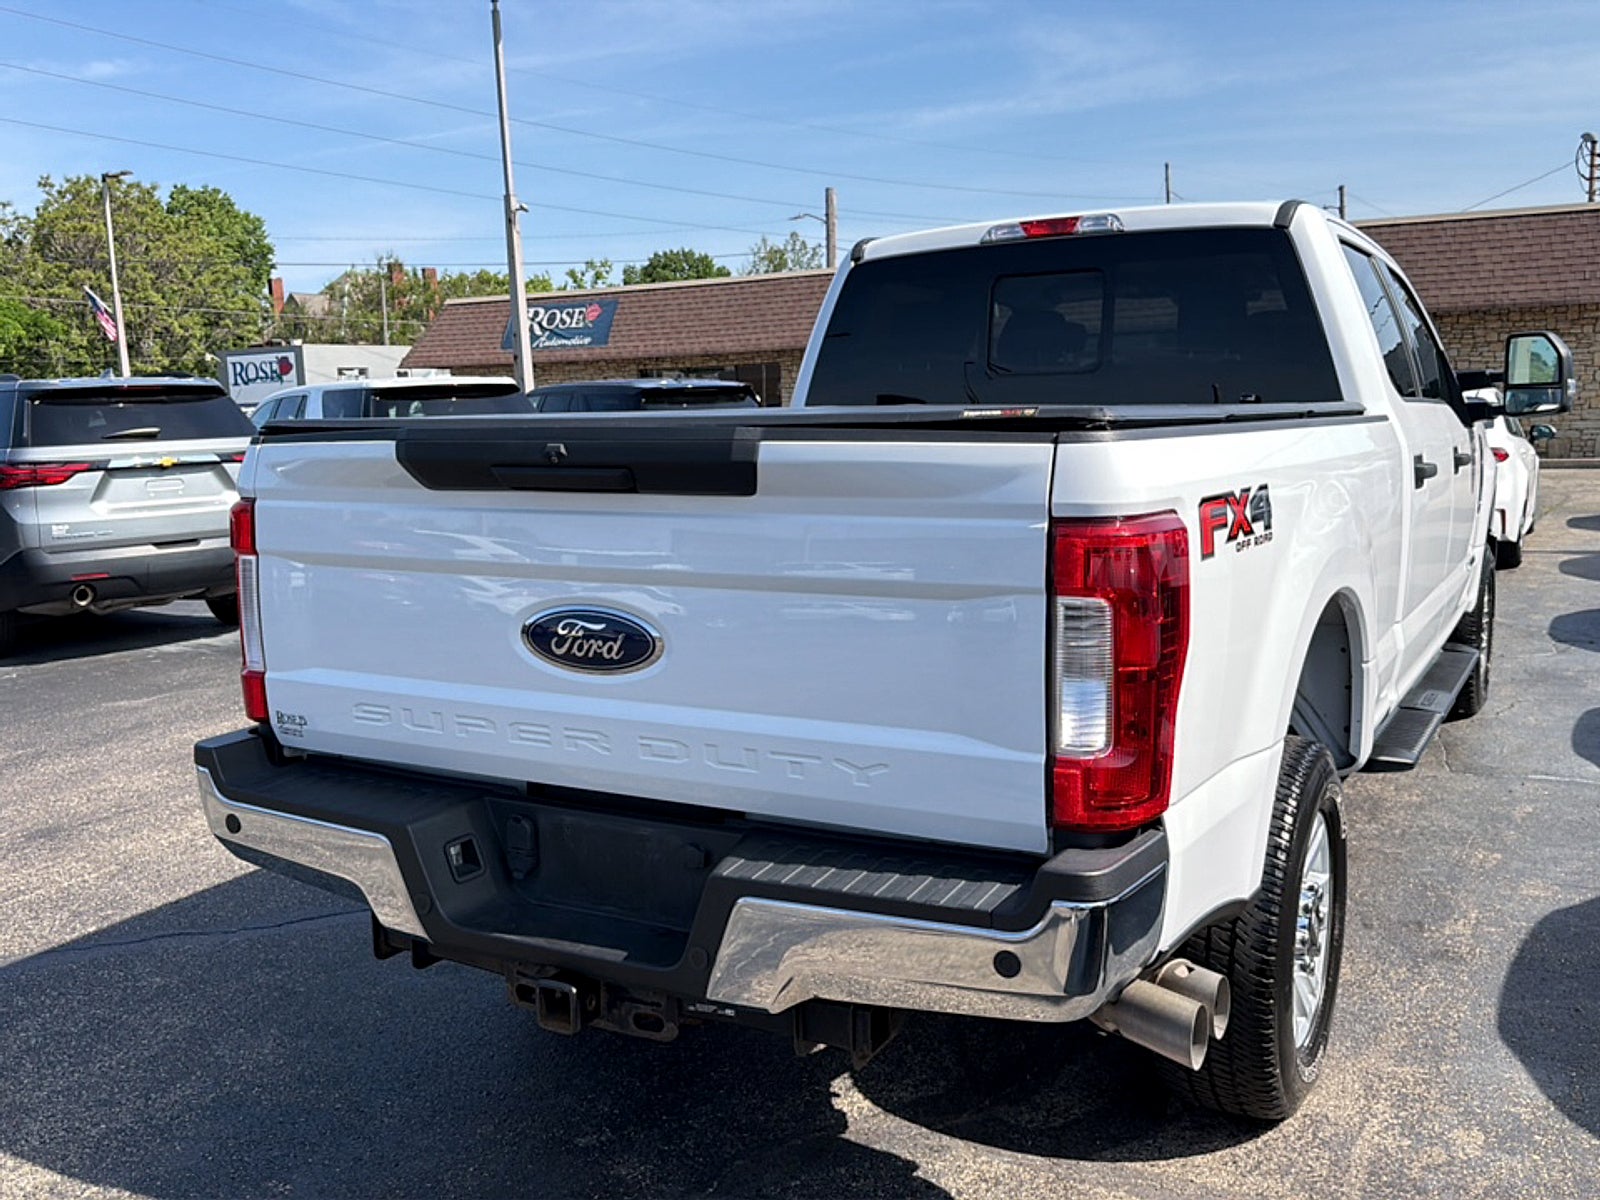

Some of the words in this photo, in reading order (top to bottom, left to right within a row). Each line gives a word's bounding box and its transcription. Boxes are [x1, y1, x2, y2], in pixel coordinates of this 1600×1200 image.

[527, 306, 586, 336] ROSE
[532, 331, 592, 348] Automotive
[230, 360, 280, 386] ROSE
[1198, 483, 1272, 562] FX4
[551, 618, 626, 660] Ford
[352, 702, 612, 755] SUPER
[637, 734, 889, 788] DUTY
